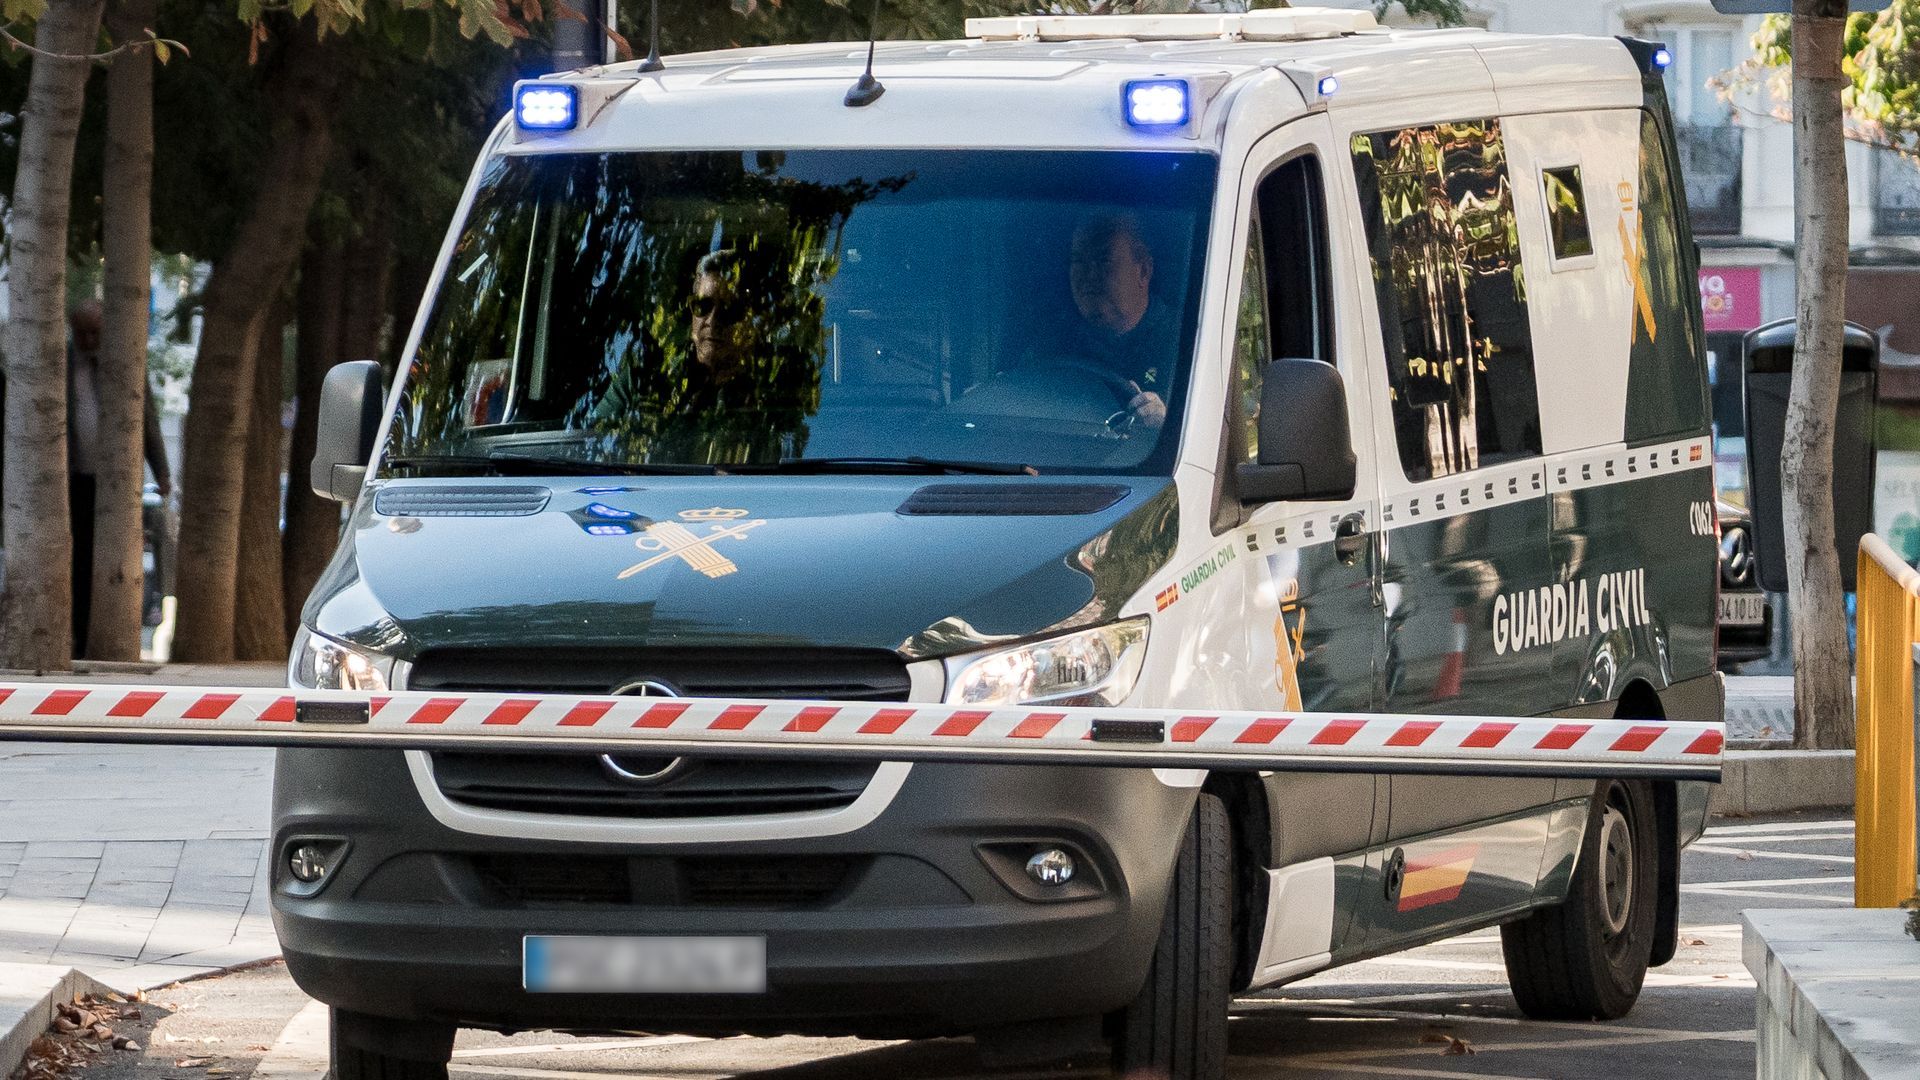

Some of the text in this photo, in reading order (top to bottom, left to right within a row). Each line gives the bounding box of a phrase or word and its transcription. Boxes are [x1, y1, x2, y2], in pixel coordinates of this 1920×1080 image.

[1181, 543, 1236, 593] GUARDIA CIVIL
[1493, 567, 1650, 655] GUARDIA CIVIL
